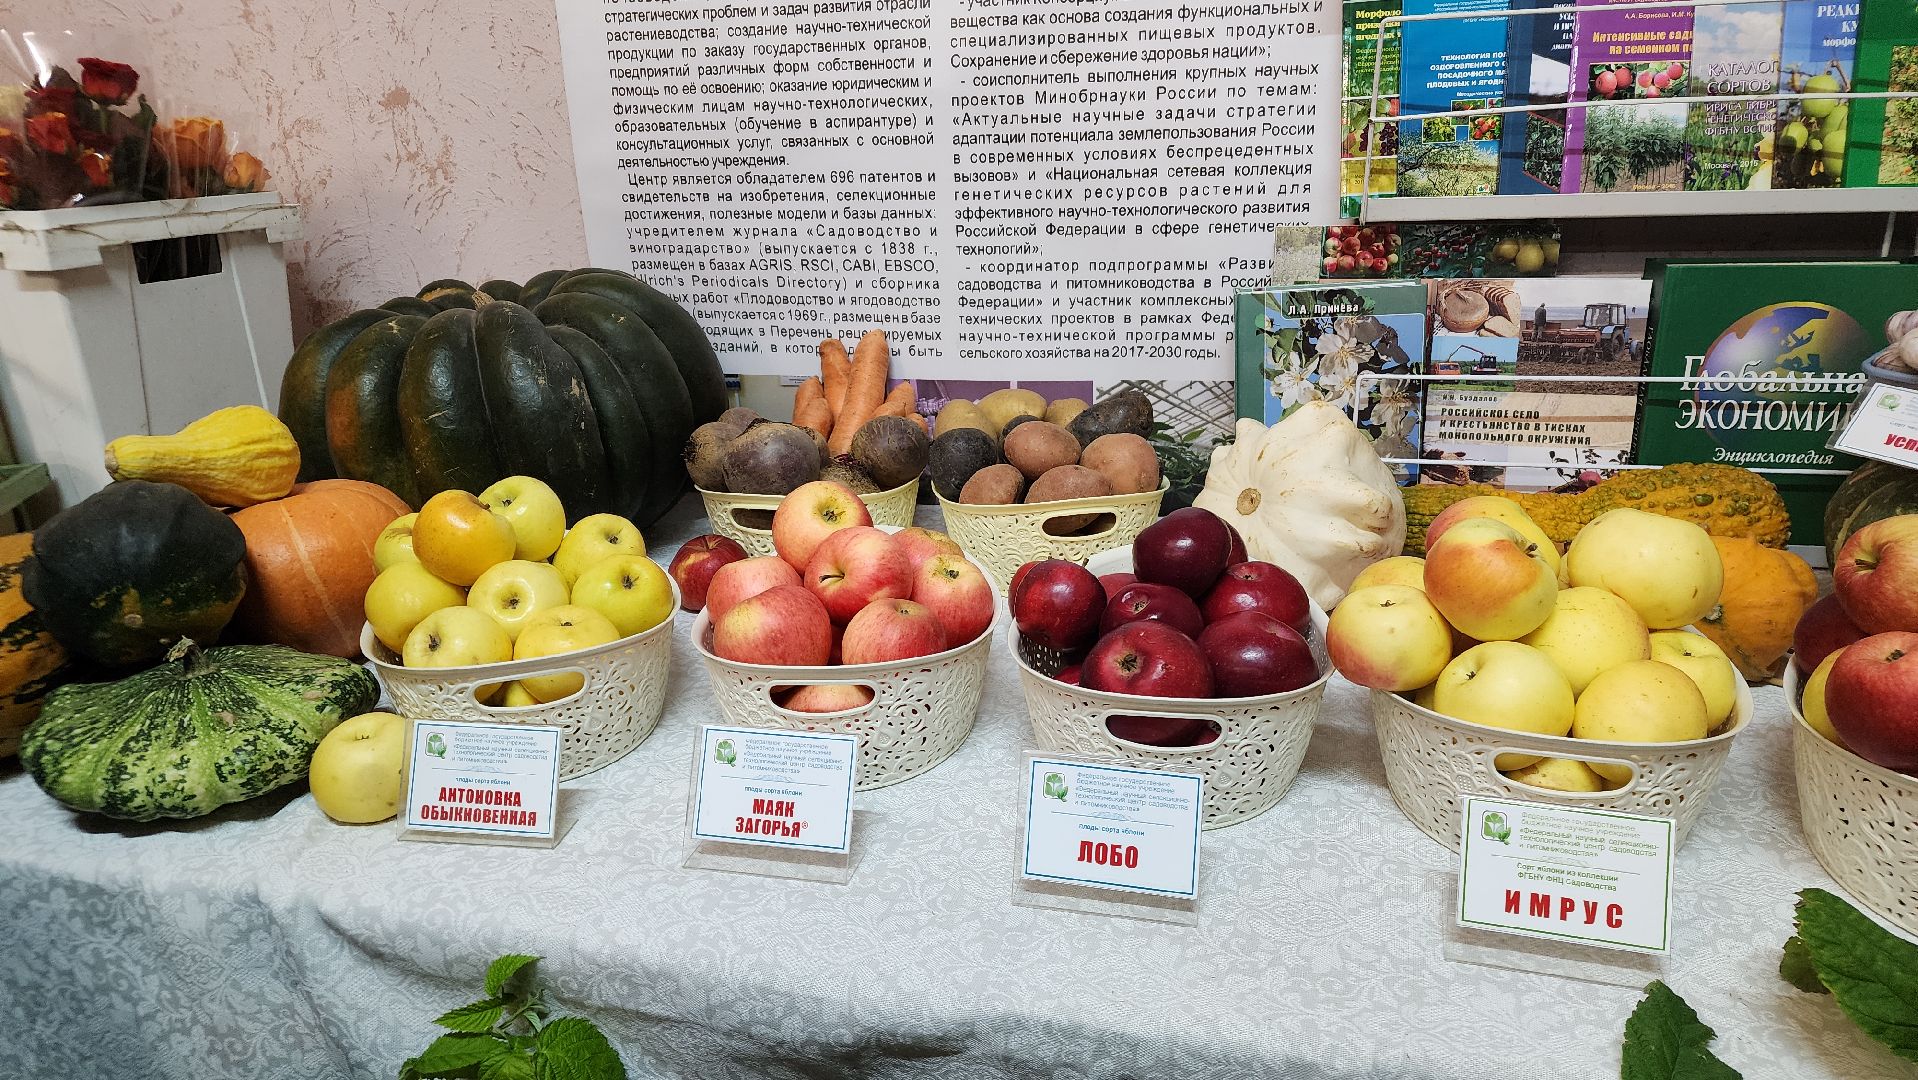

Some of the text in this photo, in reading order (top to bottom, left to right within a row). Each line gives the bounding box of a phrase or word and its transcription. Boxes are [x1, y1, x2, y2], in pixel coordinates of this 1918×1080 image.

[604, 0, 931, 26] стратегических проблем и задач развития отрасли
[950, 0, 1323, 31] вещества как основа создания функциональных и
[606, 17, 931, 46] растениеводства; создание научно-технической
[950, 22, 1321, 50] специализированных пищевых продуктов.
[1593, 31, 1667, 43] Интенсивные
[1609, 43, 1680, 55] на семенном
[609, 57, 932, 82] предприятий различных форм собственности и
[972, 72, 1080, 87] соисполнитель
[1087, 69, 1177, 83] выполнения
[1185, 66, 1247, 83] крупных
[1254, 63, 1320, 81] научных
[1707, 60, 1779, 77] КАТАЛОГ
[1707, 80, 1771, 95] СОРТОВ
[612, 95, 933, 117] физическим лицам научно-технологических,
[951, 83, 1317, 111] проектов Минобрнауки России по темам:
[1706, 102, 1742, 112] ИРИСА
[952, 122, 1315, 148] адаптации потенциала землепользования России
[621, 188, 936, 206] свидетельств на изобретения, селекционные
[954, 202, 1310, 223] эффективного научно-технологического развития
[626, 223, 938, 240] учредителем журнала «Садоводство и
[955, 220, 1310, 239] Российской Федерации в сфере генетиче
[631, 260, 695, 273] размещен
[698, 260, 706, 271] в
[708, 257, 746, 271] базах
[800, 258, 839, 274] RSCI,
[842, 258, 880, 275] CABI,
[884, 258, 939, 274] EBSCO,
[634, 272, 940, 293] lrich's Periodicals Directory) и сборника
[1287, 304, 1310, 316] Л.А.
[959, 345, 1221, 361] сельского хозяйства на 2017-2030 годы.
[1441, 407, 1541, 419] РОССИЙСКОЕ СЕЛО
[1440, 420, 1587, 433] И КРЕСТЬЯНСТВО В ТИСКАХ
[1438, 432, 1592, 445] МОНОПОЛЬНОГО ОКРУЖЕНИЯ
[1712, 447, 1834, 465] Энциклопедия
[438, 786, 522, 807] АНТОНОВКА
[421, 804, 537, 827] ОБЫКНОВЕННАЯ
[752, 798, 795, 818] МАЯК
[1077, 840, 1139, 869] ЛОБО
[1565, 878, 1617, 892] Садоводства
[1577, 870, 1618, 882] коллекции
